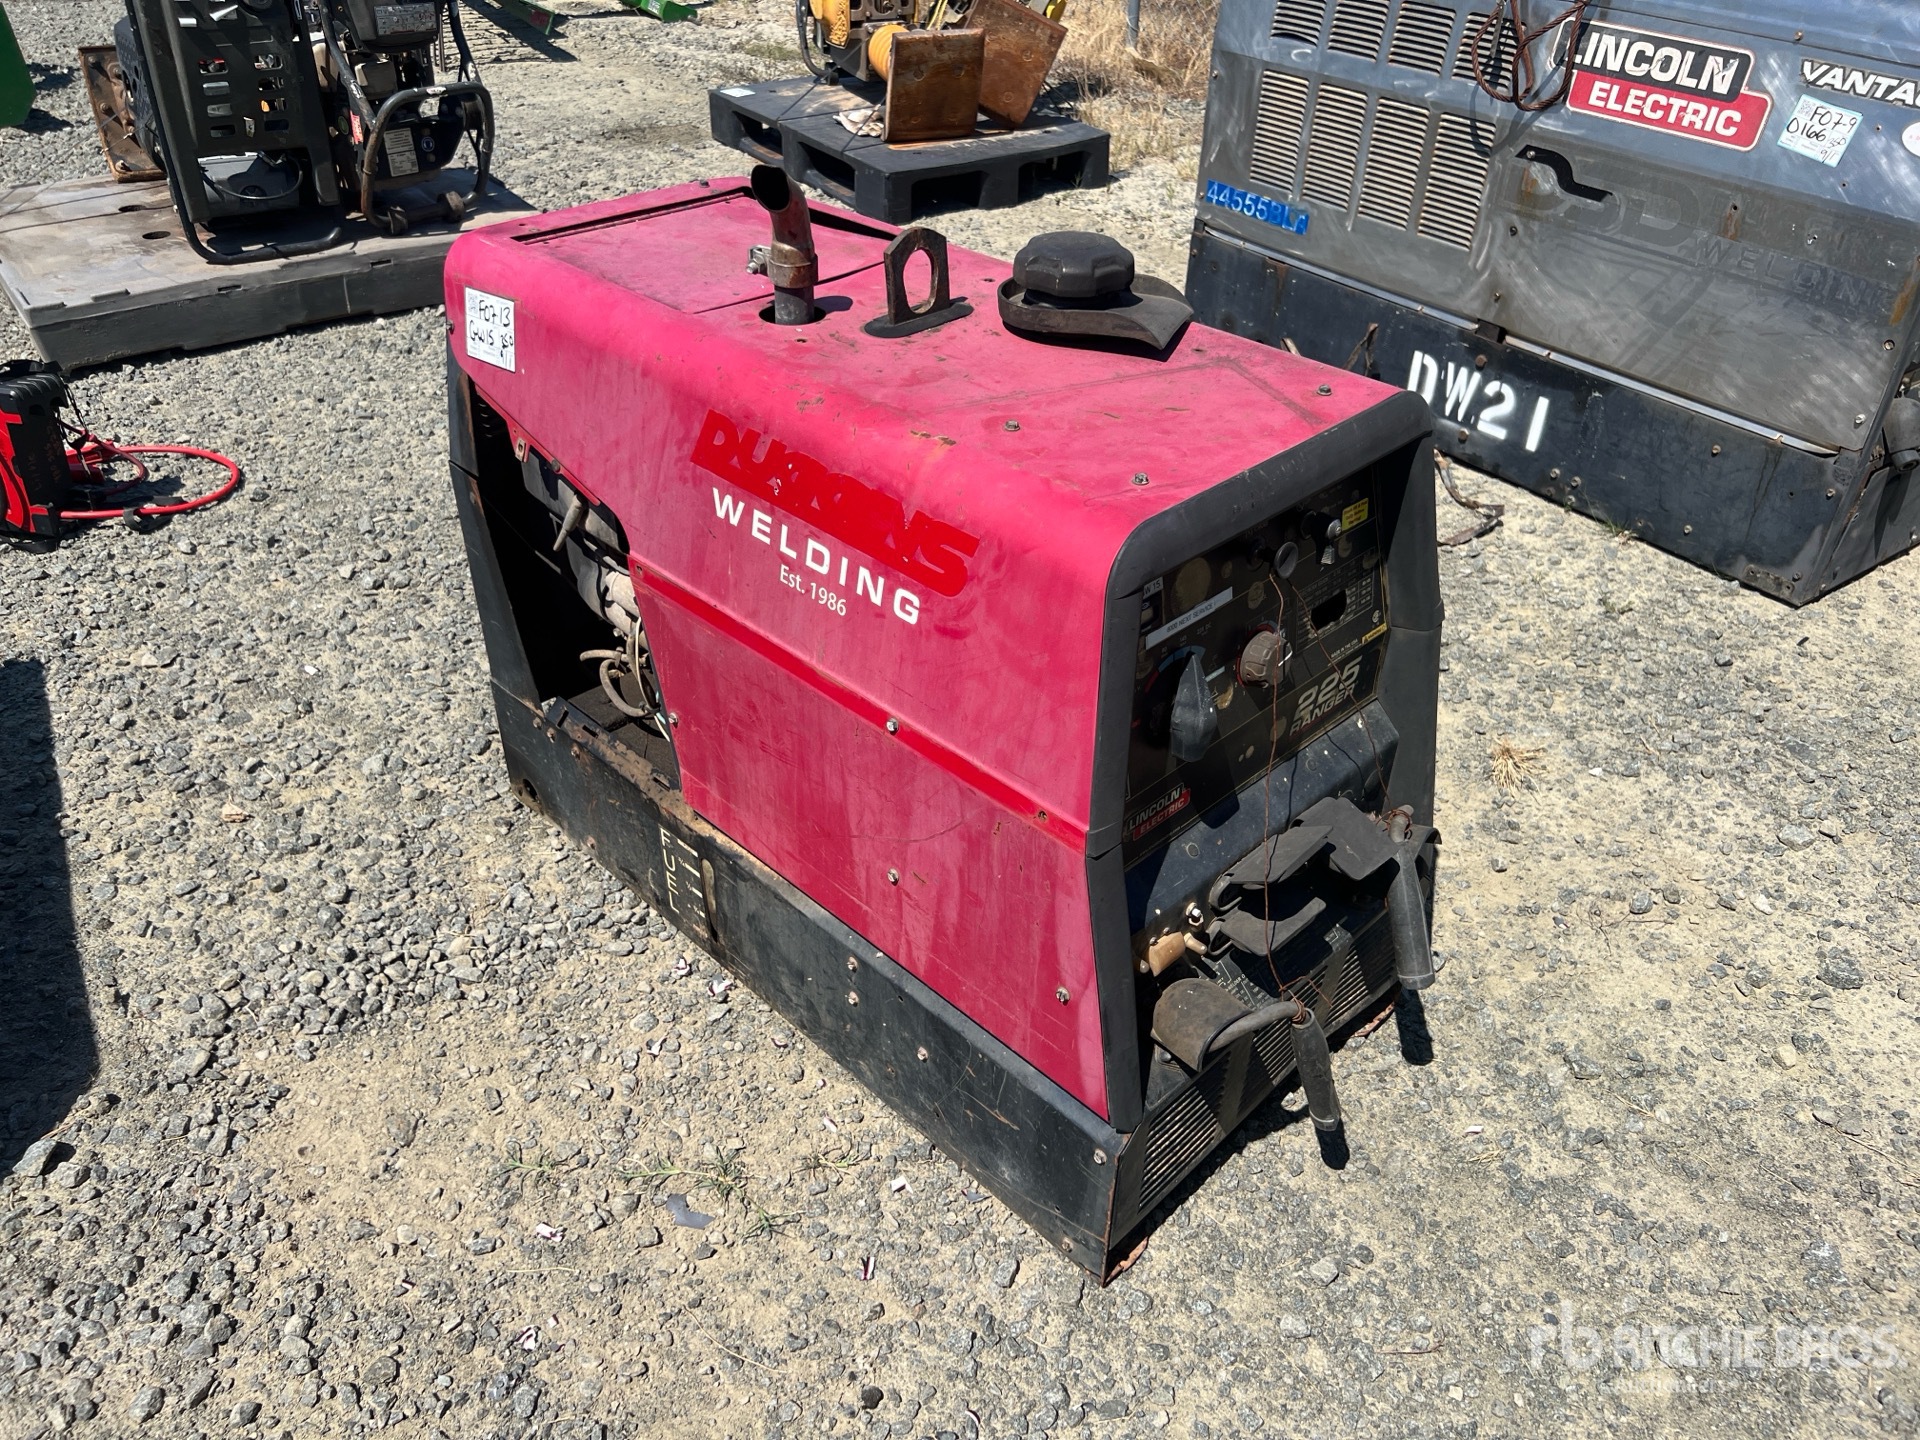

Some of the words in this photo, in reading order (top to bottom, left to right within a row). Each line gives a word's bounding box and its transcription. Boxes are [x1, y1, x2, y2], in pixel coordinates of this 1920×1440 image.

[1565, 32, 1740, 95] LINCOLN
[1588, 80, 1742, 137] ELECTRIC
[1407, 350, 1550, 453] DW21
[712, 487, 921, 625] WELDING
[780, 564, 806, 595] Est.
[810, 582, 848, 616] 1986
[1290, 682, 1356, 737] RANGER
[1294, 655, 1363, 721] 225
[1129, 787, 1181, 830] LINCOLN
[1140, 798, 1185, 834] ELECTRIC
